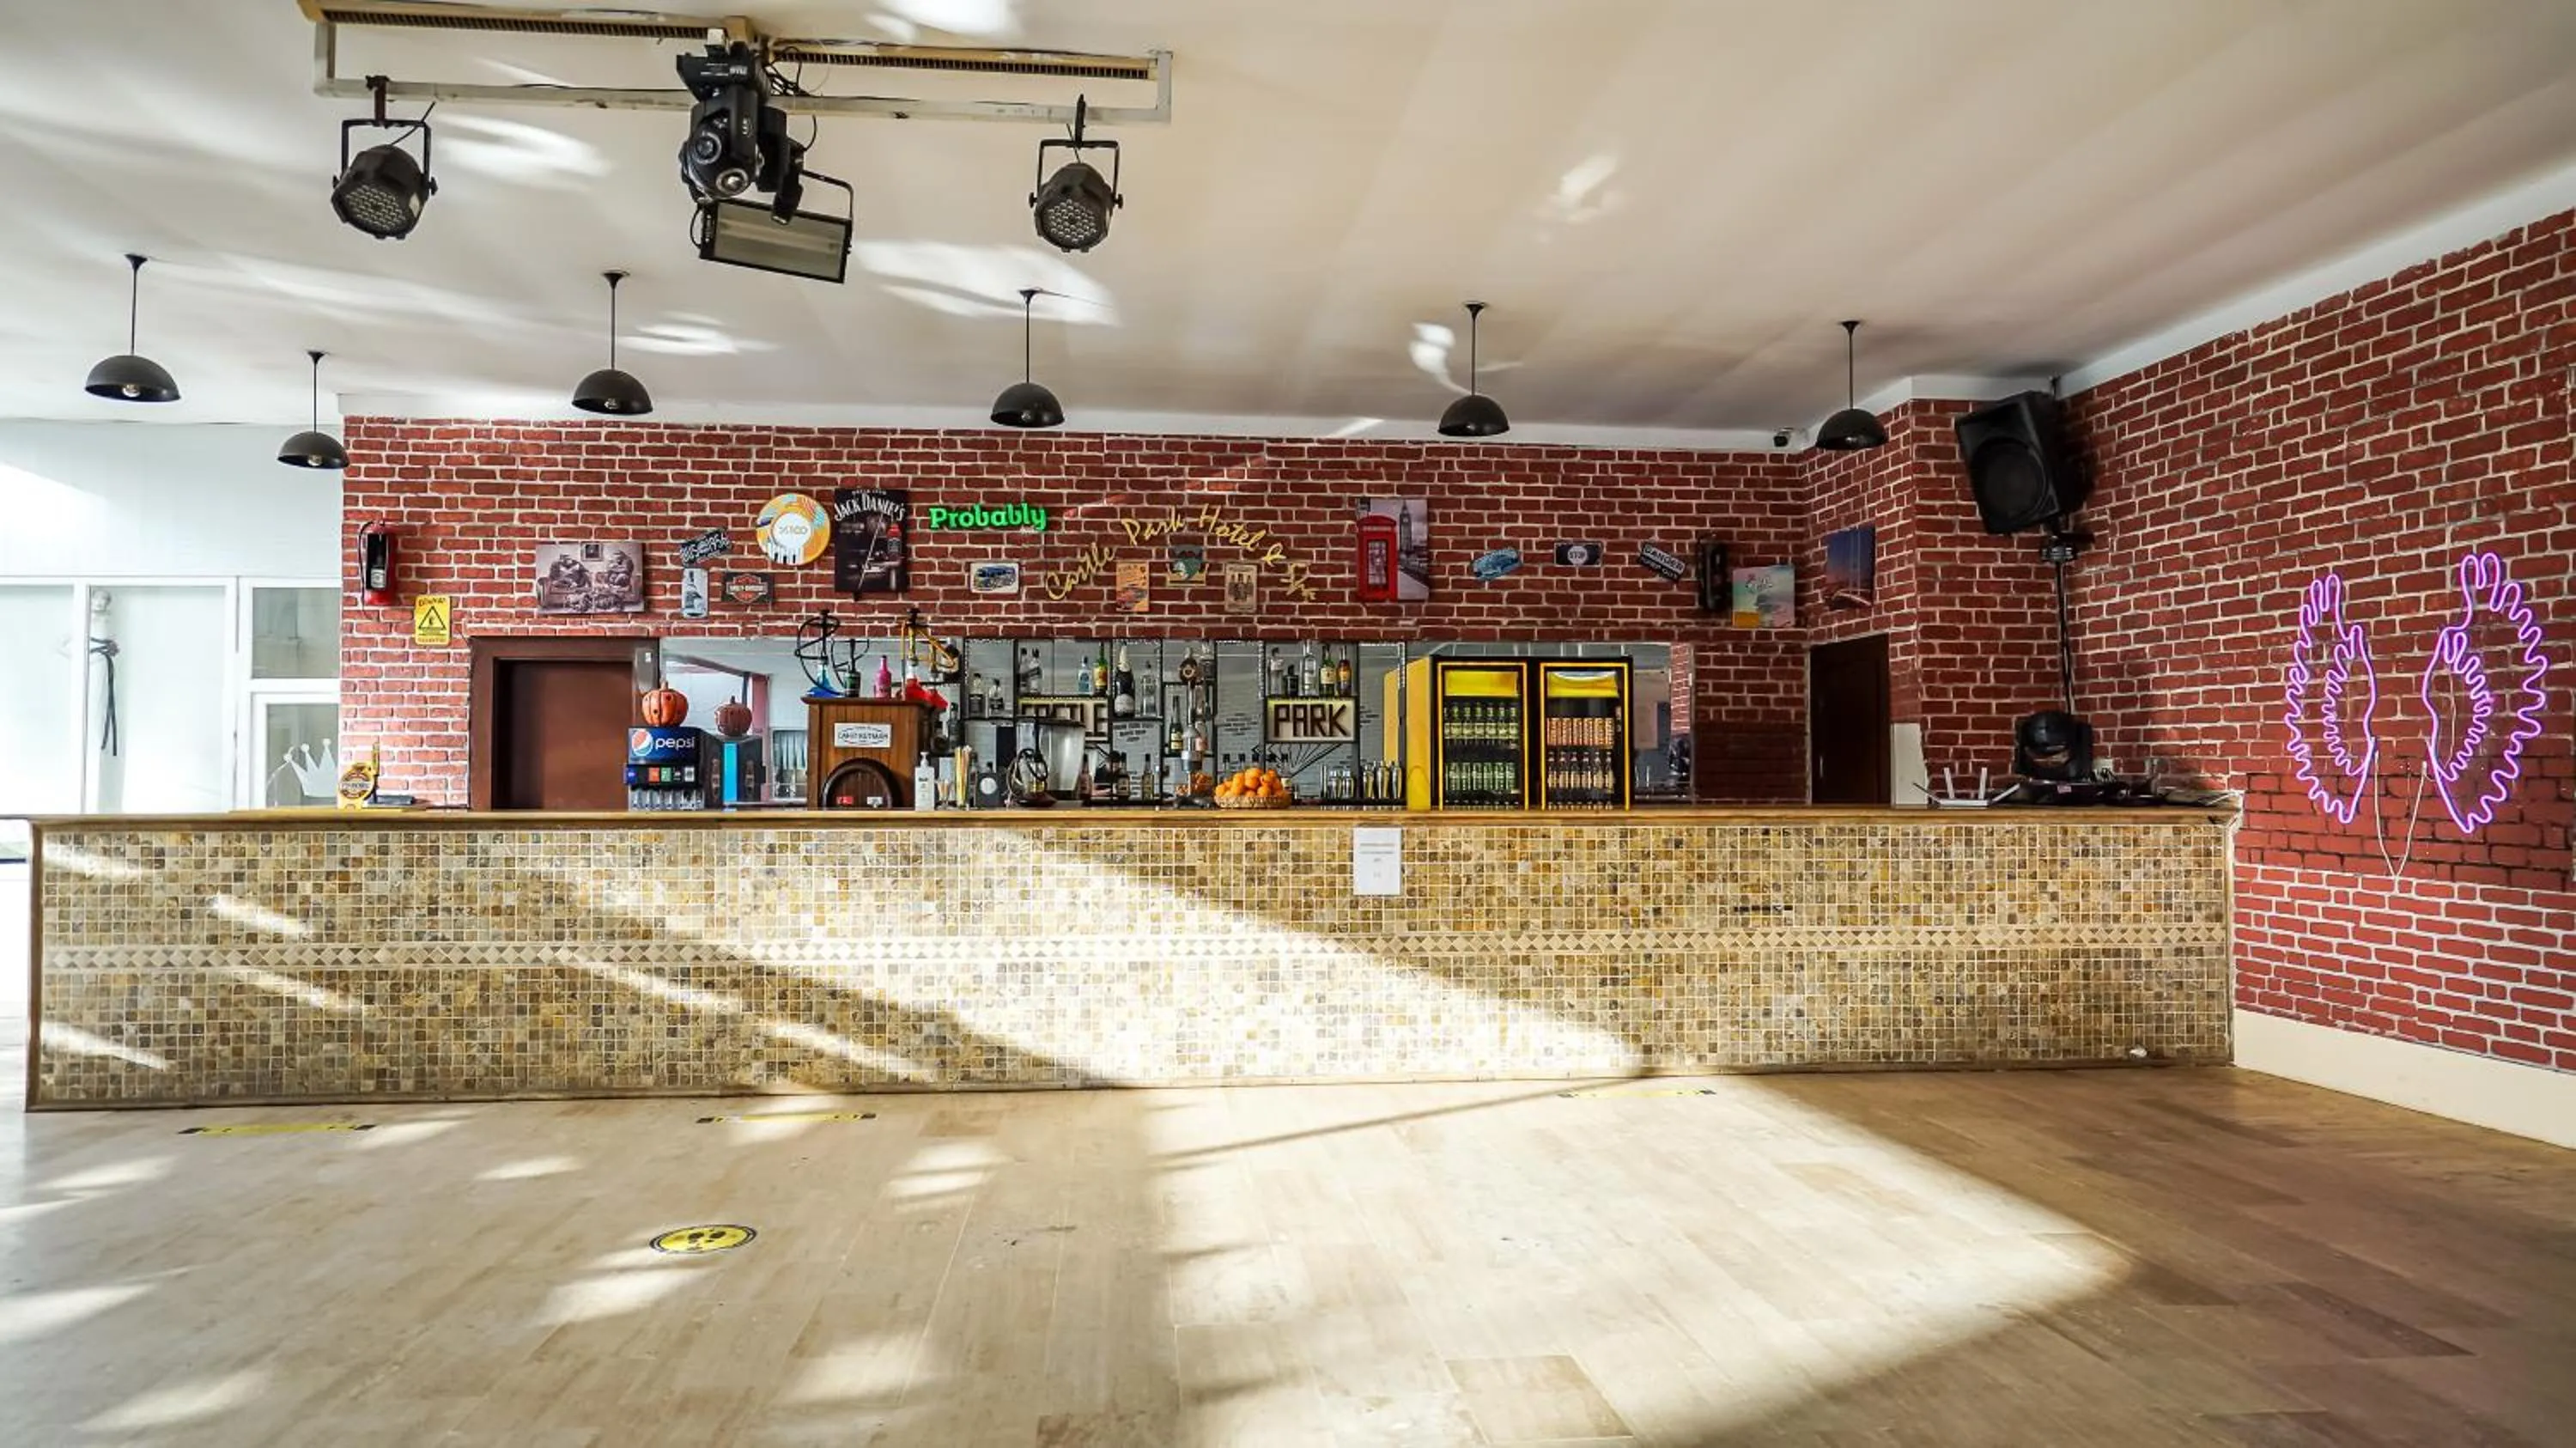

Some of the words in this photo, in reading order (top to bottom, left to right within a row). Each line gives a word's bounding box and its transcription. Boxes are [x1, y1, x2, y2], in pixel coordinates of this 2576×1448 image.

[833, 498, 861, 521] JACK
[929, 502, 1047, 531] Probably
[1045, 542, 1117, 600] Castle
[1121, 506, 1185, 546] Park
[1199, 503, 1267, 551] Hotel
[1273, 703, 1348, 737] PARK
[655, 736, 695, 751] pepsi
